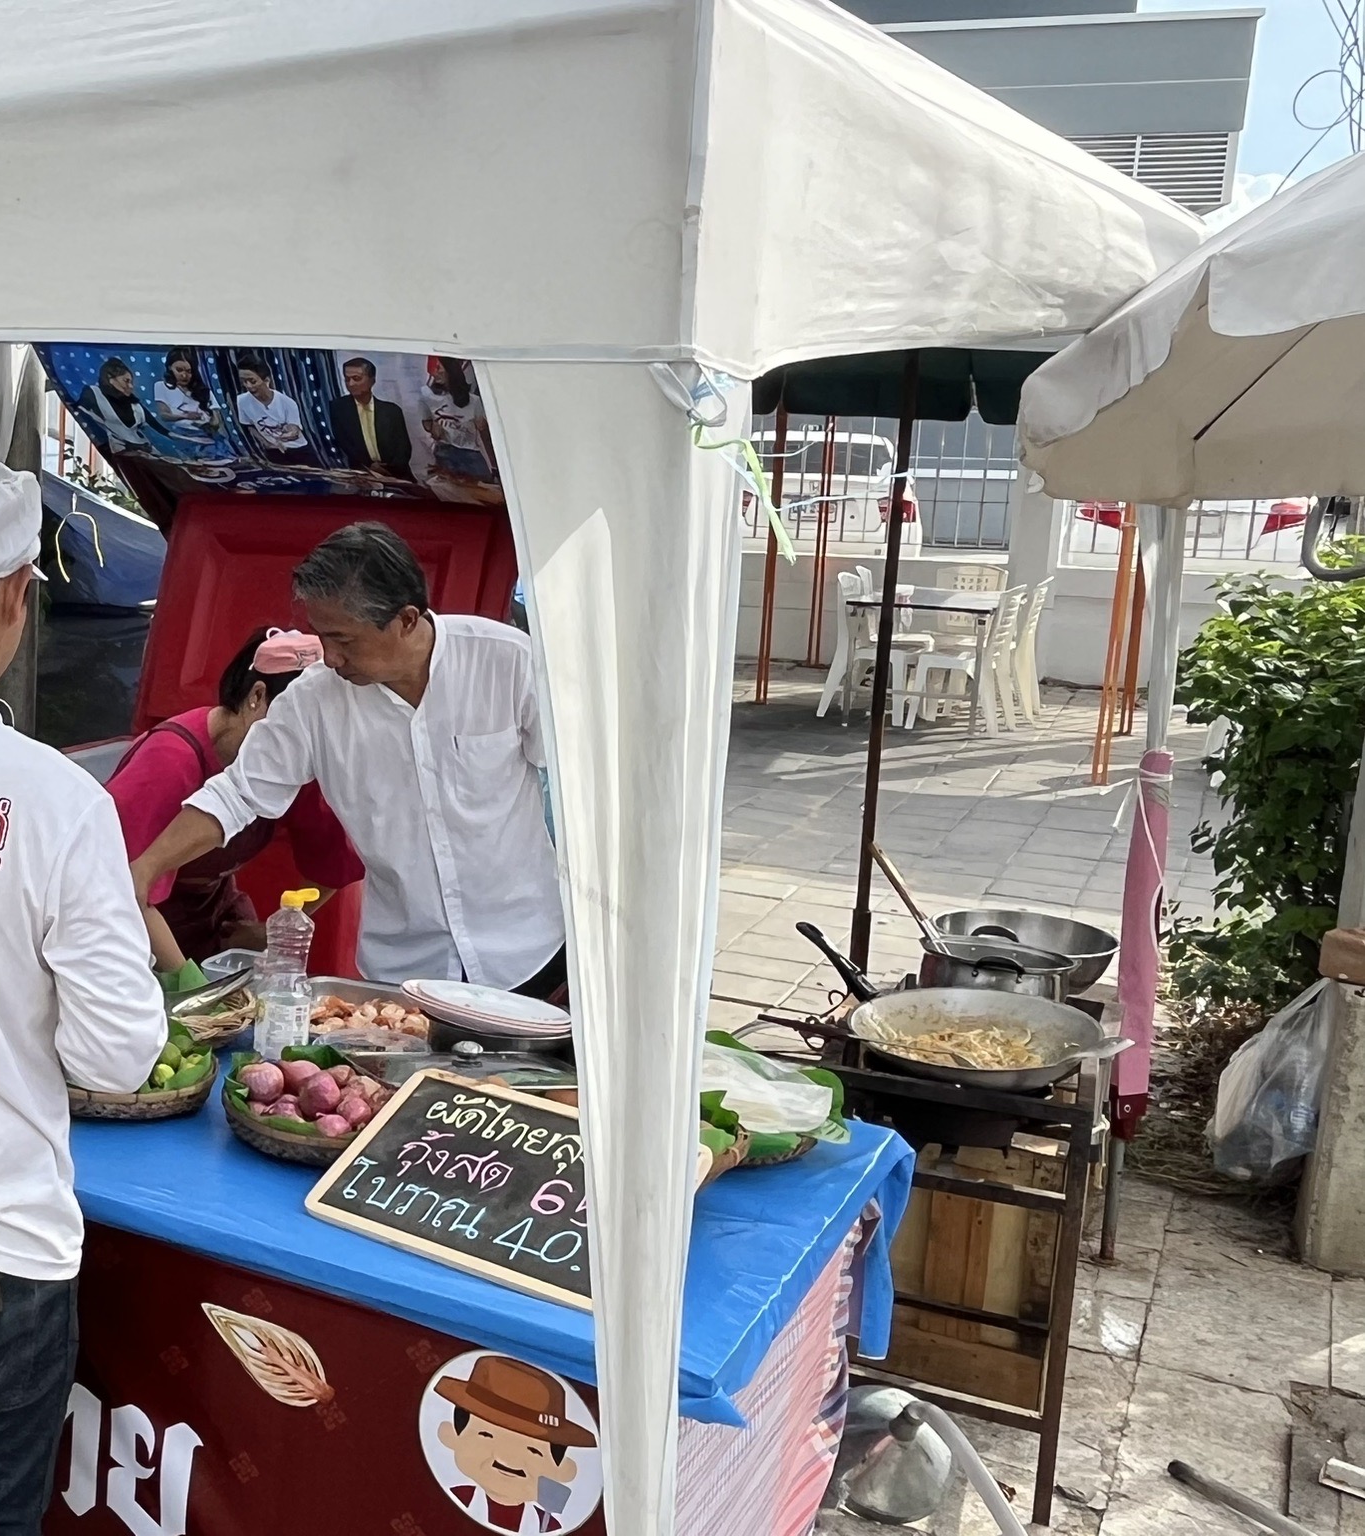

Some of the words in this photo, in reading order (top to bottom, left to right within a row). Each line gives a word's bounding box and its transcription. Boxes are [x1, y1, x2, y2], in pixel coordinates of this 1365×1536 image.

[395, 1130, 514, 1192] กุ้งสด
[425, 1092, 585, 1176] ผัดไทยลุ
[340, 1155, 489, 1241] โบราณ
